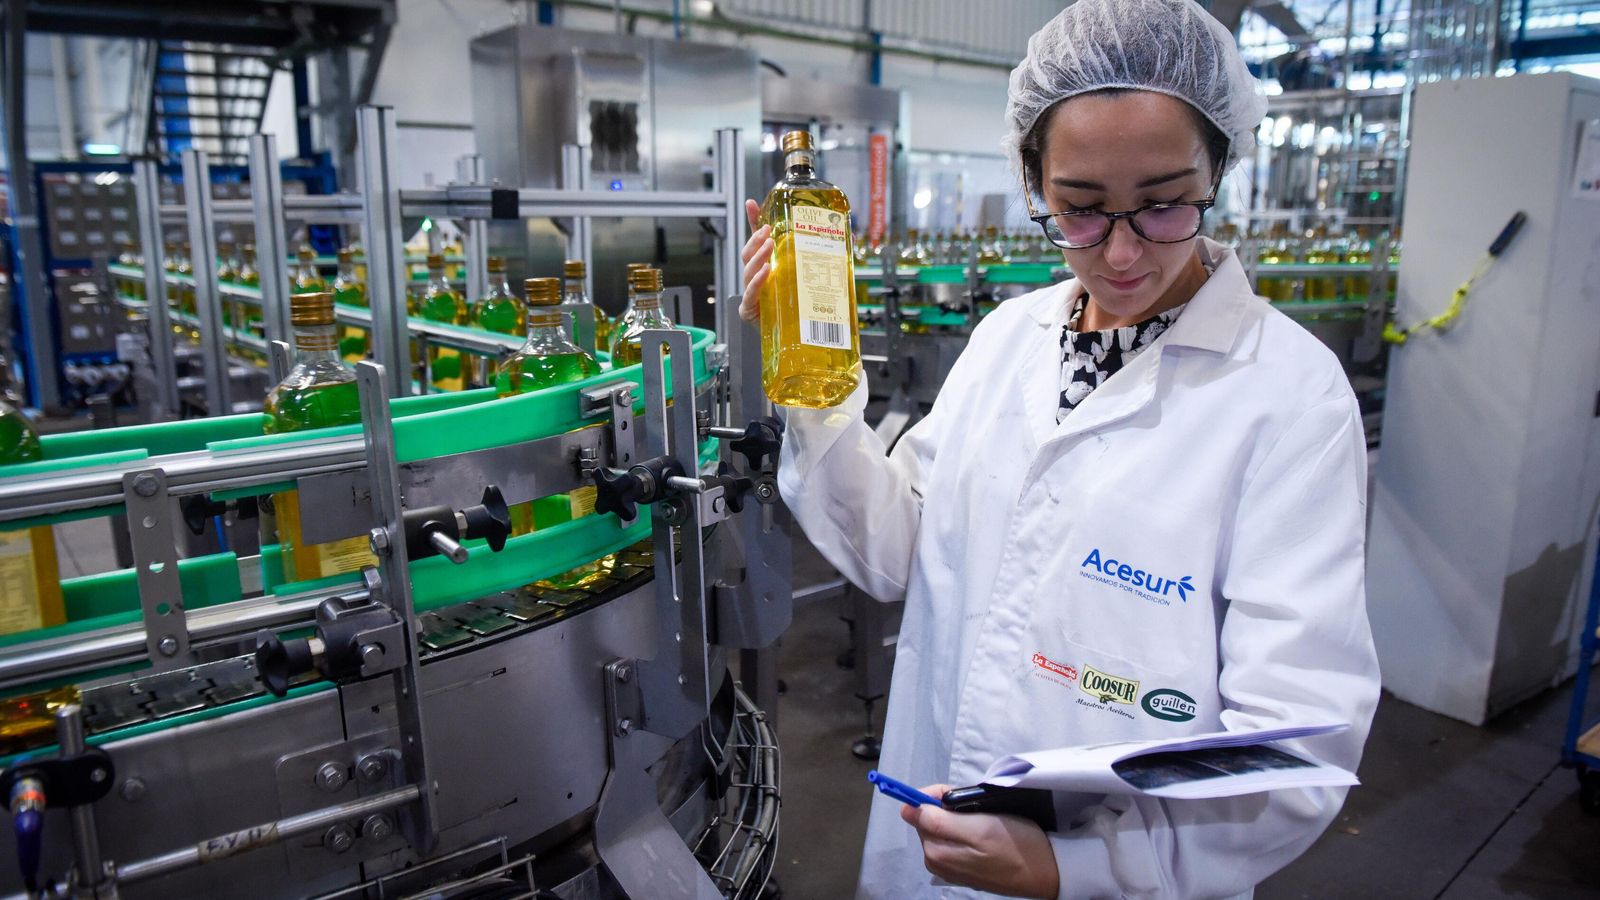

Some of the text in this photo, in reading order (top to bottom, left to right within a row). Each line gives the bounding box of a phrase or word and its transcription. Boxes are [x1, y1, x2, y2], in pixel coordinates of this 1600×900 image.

[1079, 570, 1118, 588] INNOVAMOS
[1118, 584, 1133, 594] POR
[1081, 548, 1177, 595] Acesur
[1033, 655, 1043, 664] La
[1075, 697, 1135, 720] Maestros Aceiteros
